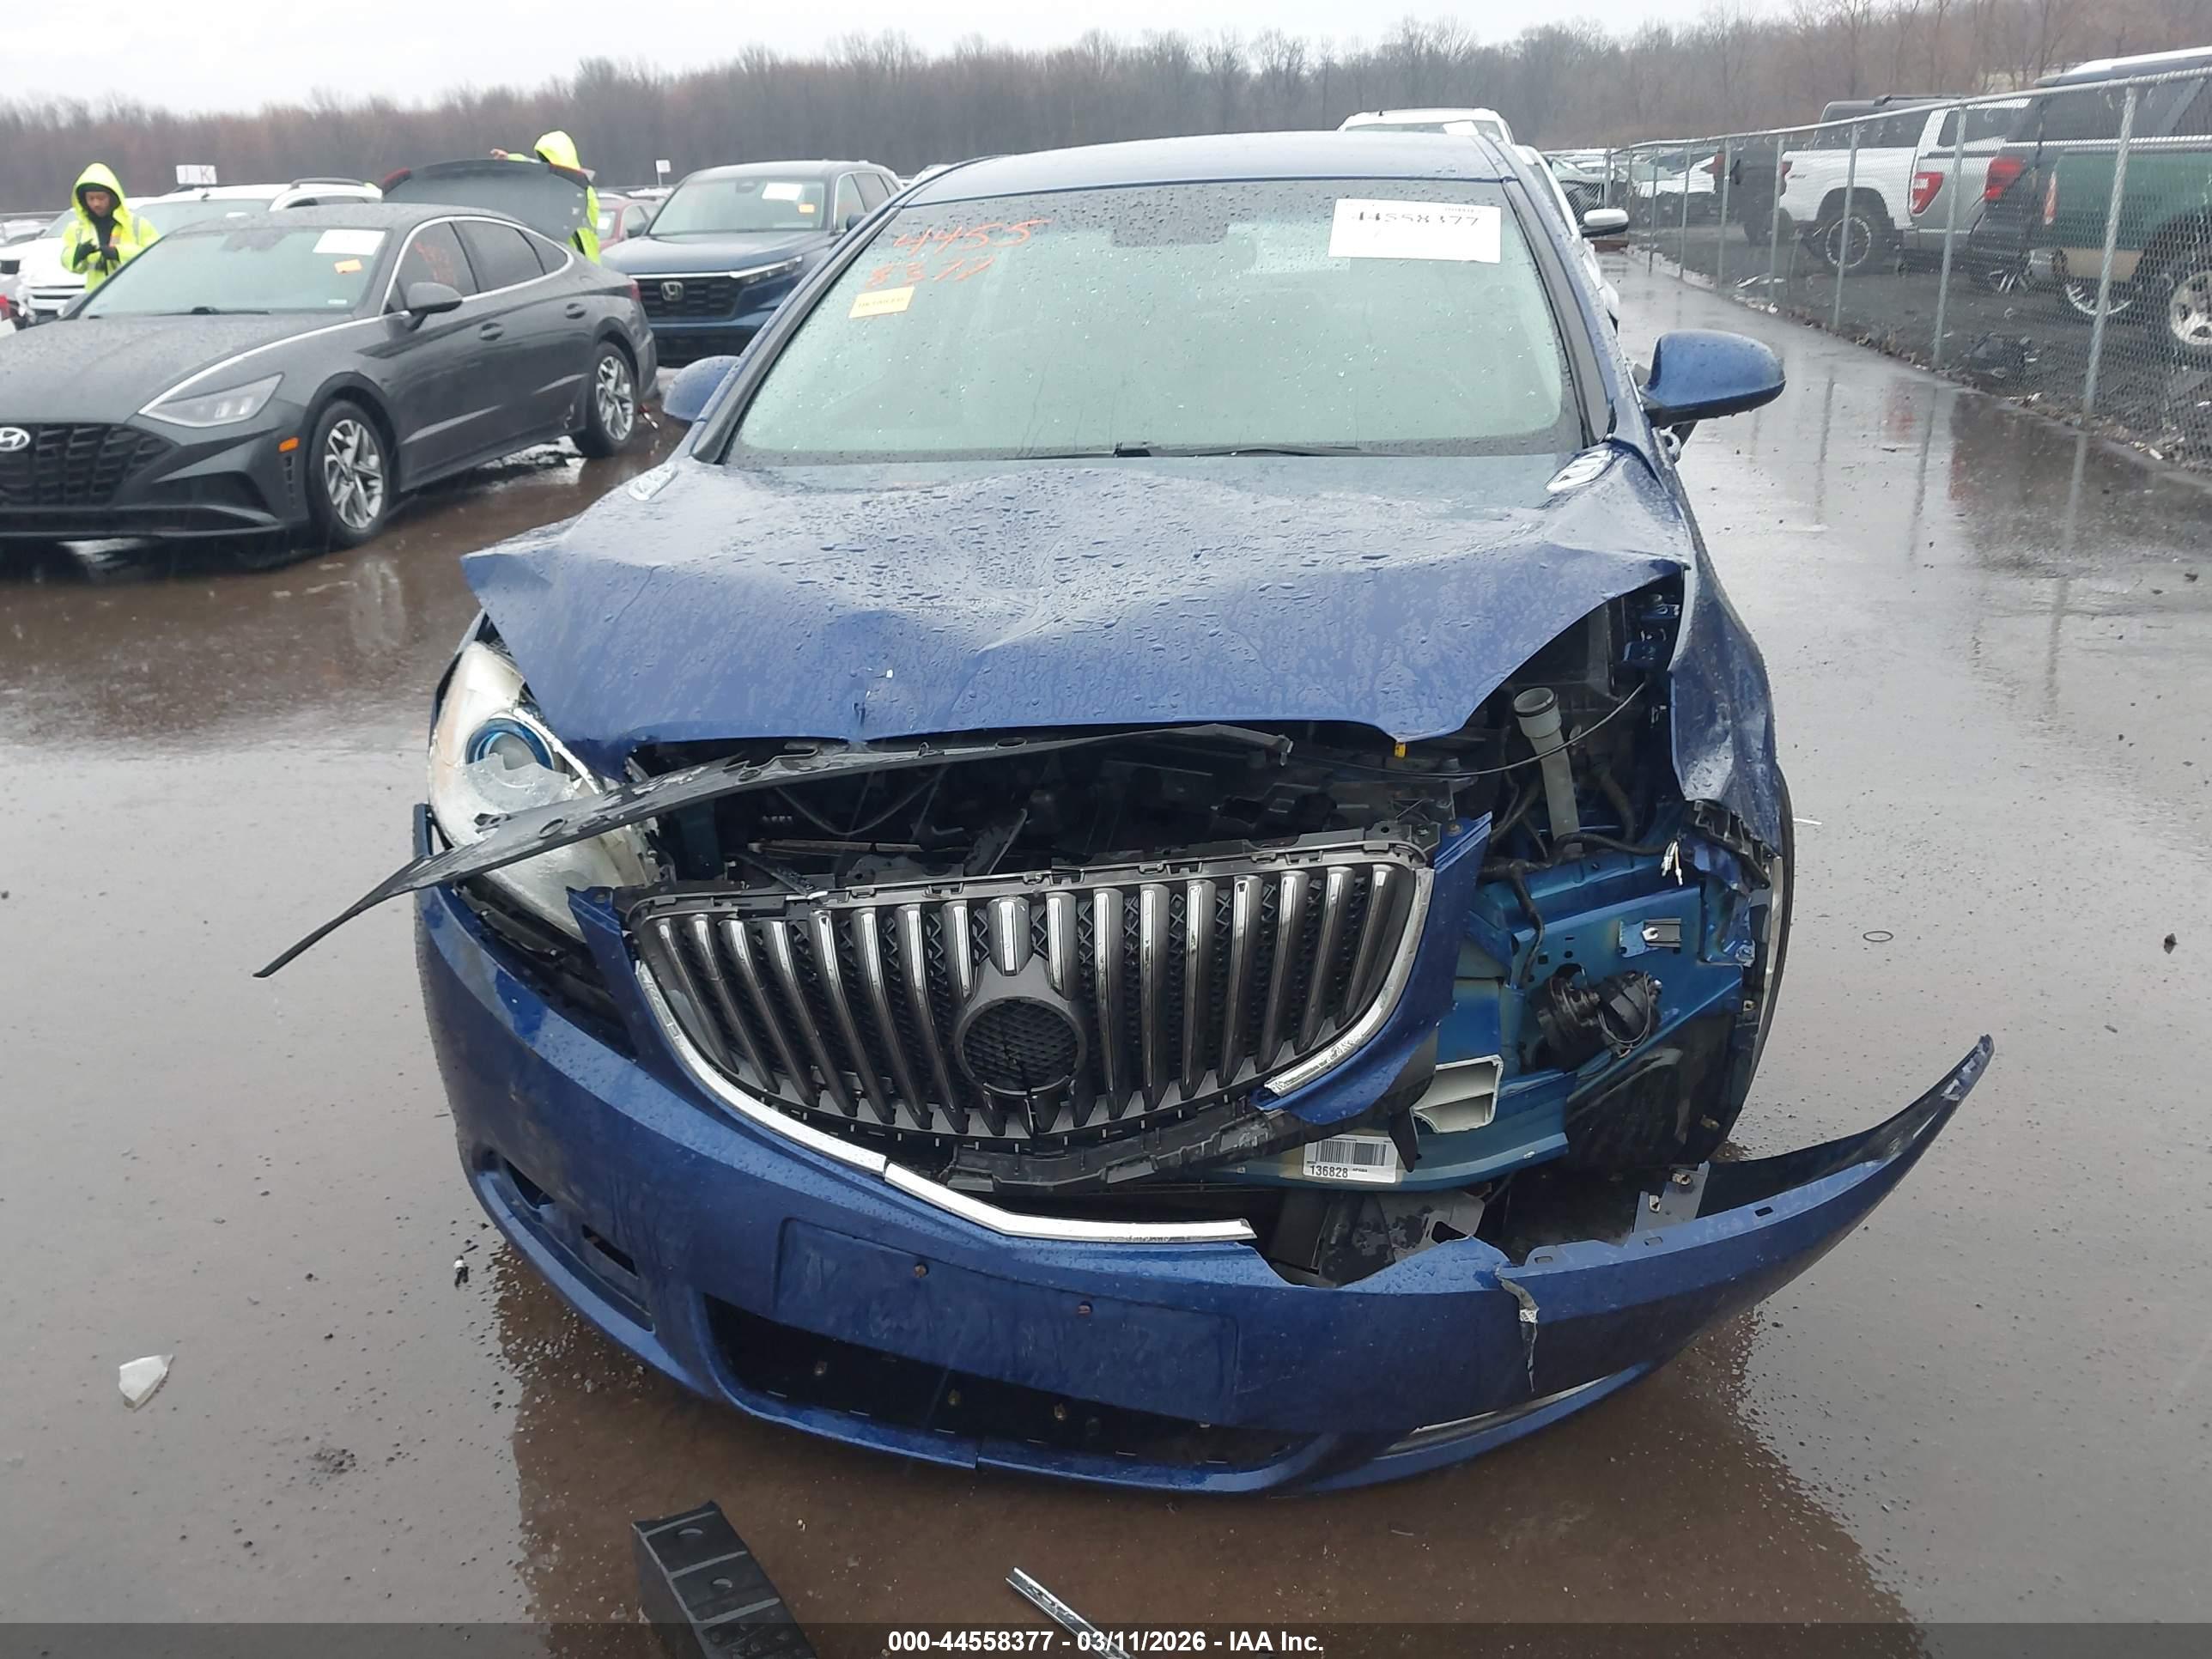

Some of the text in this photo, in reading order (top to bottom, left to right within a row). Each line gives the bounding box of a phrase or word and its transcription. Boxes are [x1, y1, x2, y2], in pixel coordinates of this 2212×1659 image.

[893, 218, 1053, 257] 4455
[866, 257, 996, 289] 8377
[1310, 1164, 1348, 1178] 136828
